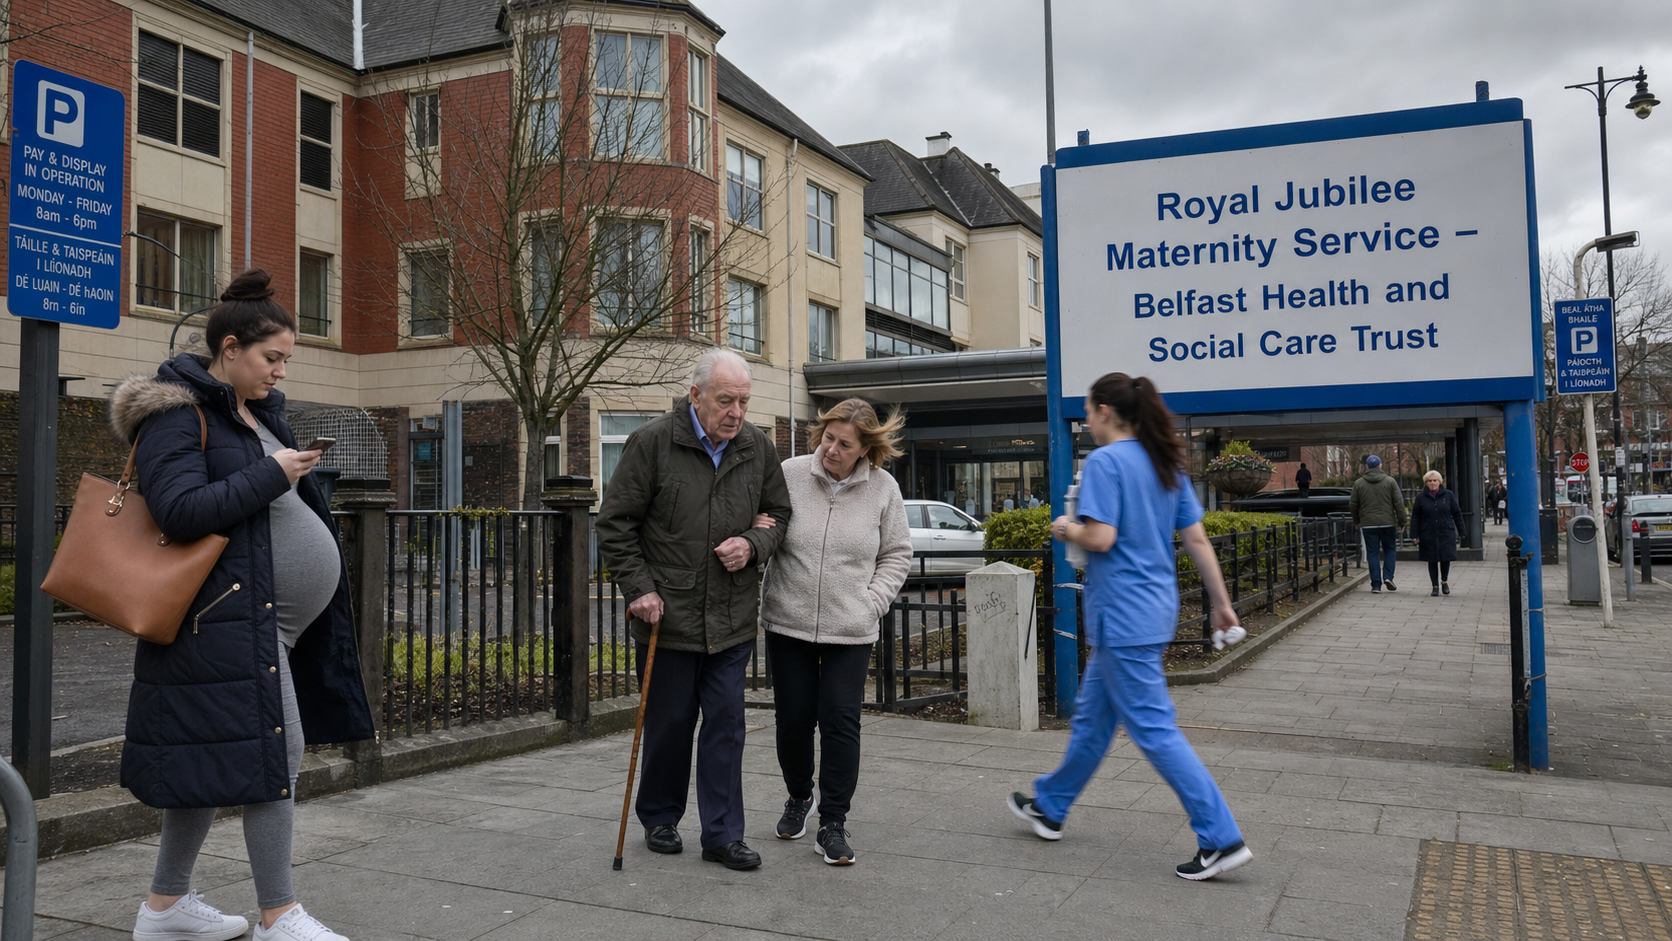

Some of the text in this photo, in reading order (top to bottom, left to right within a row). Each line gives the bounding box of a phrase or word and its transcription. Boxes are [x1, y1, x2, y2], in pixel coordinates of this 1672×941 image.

[45, 88, 78, 135] P
[24, 145, 106, 177] PAY & DISPLAY
[25, 163, 104, 193] IN OPERATION
[18, 184, 64, 205] MONDAY
[76, 197, 112, 216] FRIDAY
[1157, 175, 1415, 224] Royal Jubilee
[36, 206, 60, 222] 8am
[73, 214, 97, 230] 6pm
[15, 235, 114, 266] TÁILLE & TAISPEÁIN
[1107, 233, 1277, 271] Maternity
[1294, 222, 1440, 257] Service
[16, 273, 28, 288] DÉ
[33, 278, 60, 293] LUAIN
[69, 282, 81, 297] DÉ
[85, 286, 113, 301] hAOIN
[1134, 273, 1449, 318] Belfast Health and
[70, 302, 85, 315] 6in
[1149, 322, 1439, 362] Social Care Trust
[1576, 331, 1593, 351] P
